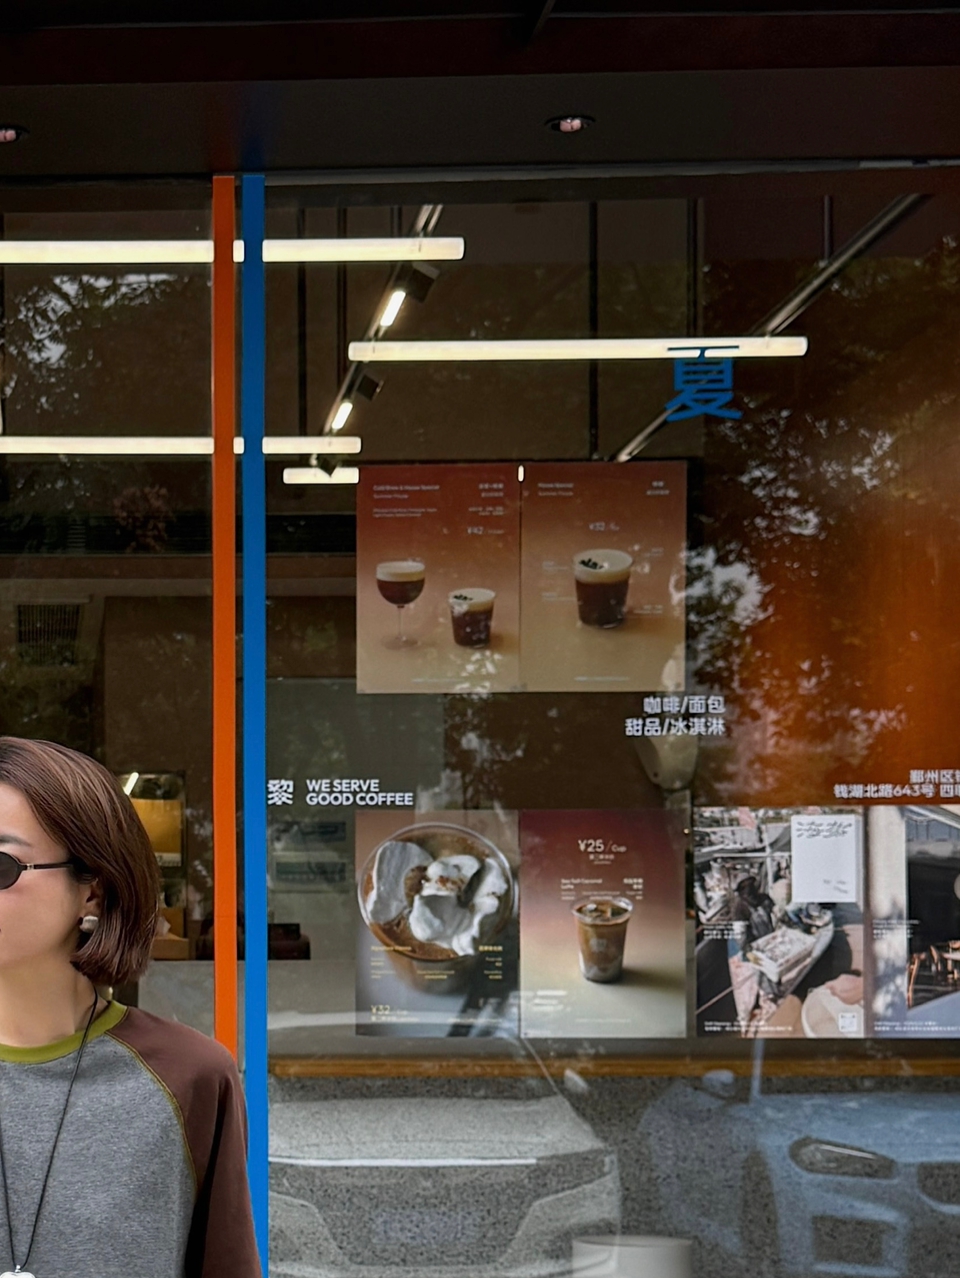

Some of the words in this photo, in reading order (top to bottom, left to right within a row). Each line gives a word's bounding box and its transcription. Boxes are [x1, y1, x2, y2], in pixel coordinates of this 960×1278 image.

[666, 345, 743, 422] 夏
[643, 696, 726, 714] 咖啡/面包
[625, 717, 726, 736] 甜品/冰淇淋
[306, 779, 331, 792] WE
[333, 779, 380, 792] SERVE
[306, 792, 354, 805] GOOD
[356, 792, 414, 805] COFFEE
[578, 839, 604, 852] ¥25
